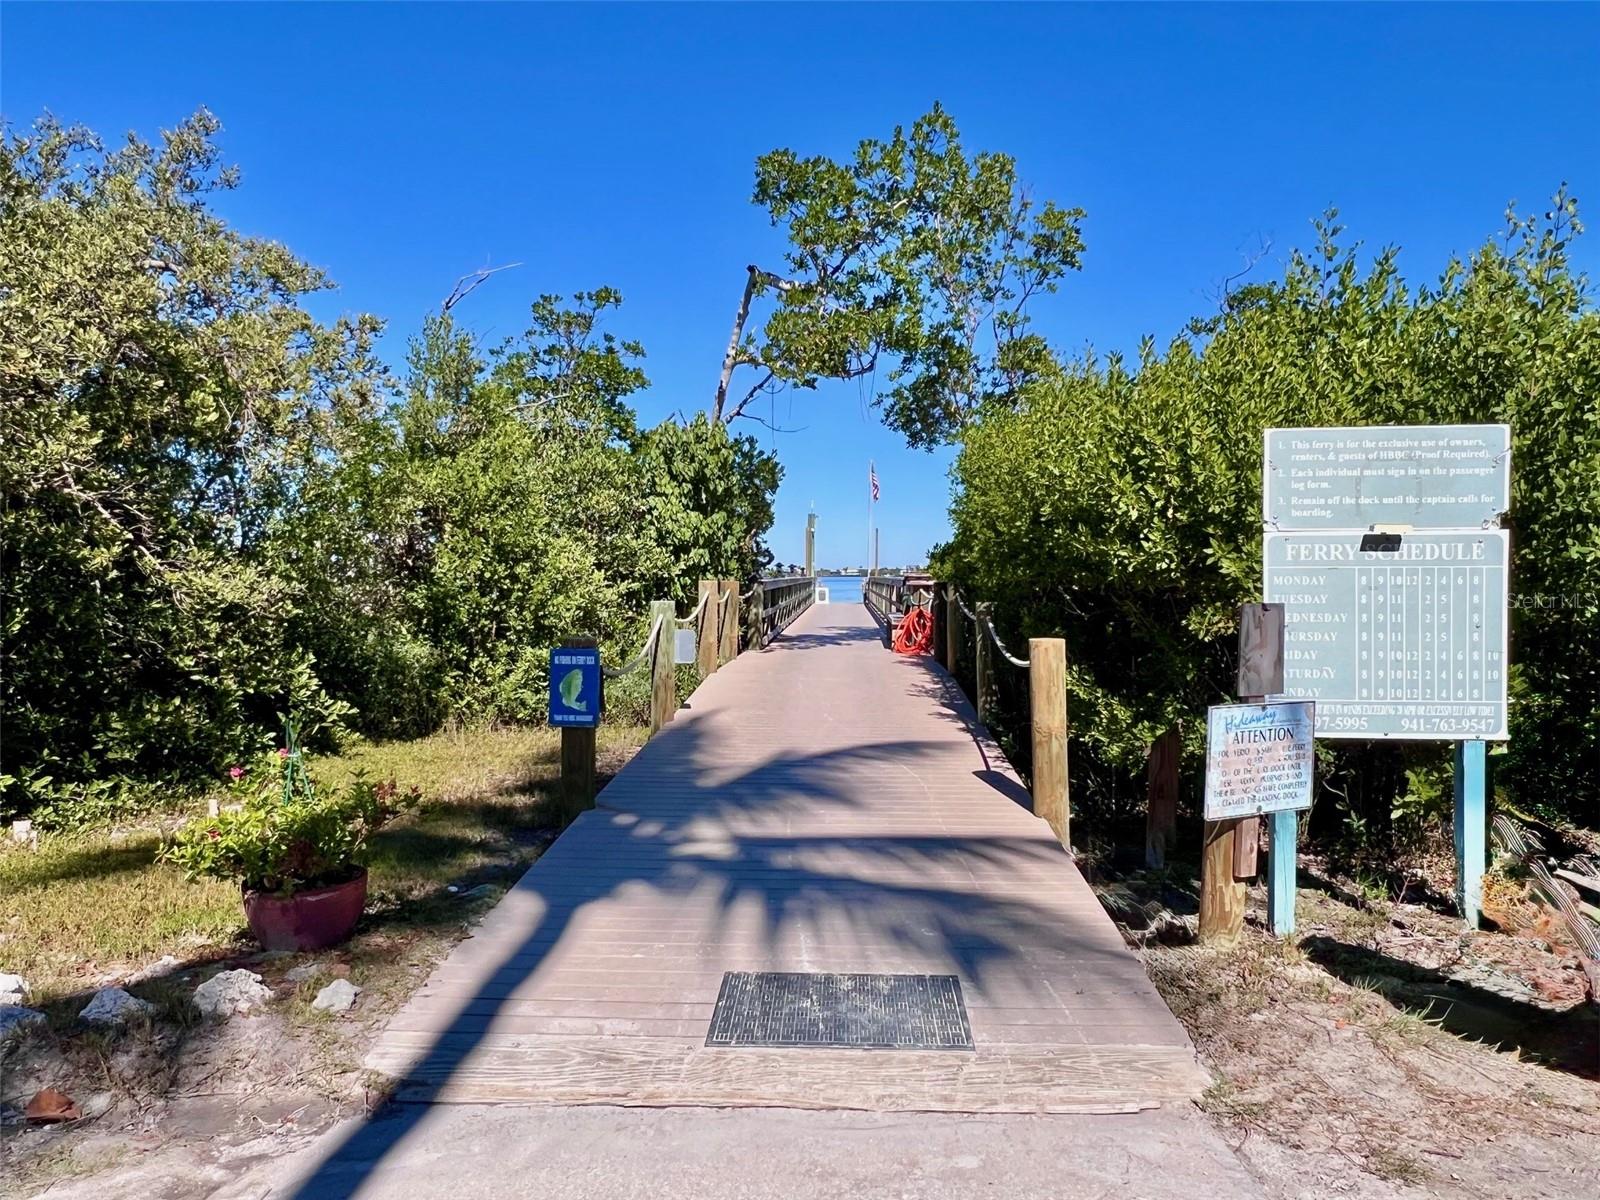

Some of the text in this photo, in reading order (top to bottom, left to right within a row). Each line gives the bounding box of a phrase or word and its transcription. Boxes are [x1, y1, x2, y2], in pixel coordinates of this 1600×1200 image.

[1291, 440, 1309, 449] This
[1312, 440, 1334, 451] ferry
[1337, 440, 1344, 448] is
[1347, 439, 1360, 448] for
[1362, 440, 1376, 448] the
[1378, 438, 1418, 448] exclusive
[1438, 438, 1449, 447] of
[1450, 439, 1486, 447] owners,
[1291, 453, 1326, 461] renters,
[1328, 452, 1336, 460] &
[1338, 452, 1366, 462] guests
[1368, 451, 1378, 459] of
[1411, 450, 1441, 460] (Proof
[1443, 449, 1491, 460] Required).
[1291, 468, 1313, 477] Each
[1316, 467, 1361, 477] individual
[1363, 467, 1385, 476] must
[1386, 466, 1405, 478] sign
[1408, 467, 1416, 475] in
[1433, 466, 1447, 475] the
[1449, 468, 1496, 476] passenger
[1291, 480, 1332, 490] log form.
[1291, 496, 1323, 504] Remain
[1327, 496, 1342, 504] off
[1342, 496, 1356, 504] the
[1358, 495, 1380, 504] dock
[1382, 495, 1403, 504] until
[1405, 495, 1420, 504] the
[1421, 495, 1456, 506] captain
[1457, 495, 1478, 503] calls
[1480, 494, 1496, 503] for
[1291, 508, 1334, 519] boarding.
[1286, 542, 1485, 561] FERRY SCHEDULE
[1273, 575, 1479, 585] MONDAY 8 9 10 12 2 4 6 8
[1273, 594, 1479, 604] TUESDAY 8 9 11 2 5 8
[1284, 612, 1479, 623] EDNESDAY 8 9 11 2 5 8
[1285, 632, 1479, 642] URSDAY 8 9 11 2 5 8
[1284, 650, 1498, 660] IDAY 8 9 10 12 2 4 6 8 10
[1284, 668, 1498, 680] TURDAY 8 9 10 12 2 4 6 8 10
[1284, 687, 1479, 698] NDAY 8 9 10 12 2 4 6 8
[1225, 710, 1276, 735] Hideaway
[1315, 716, 1495, 732] 97-5995 941-763-9547
[1232, 727, 1295, 745] ATTENTION
